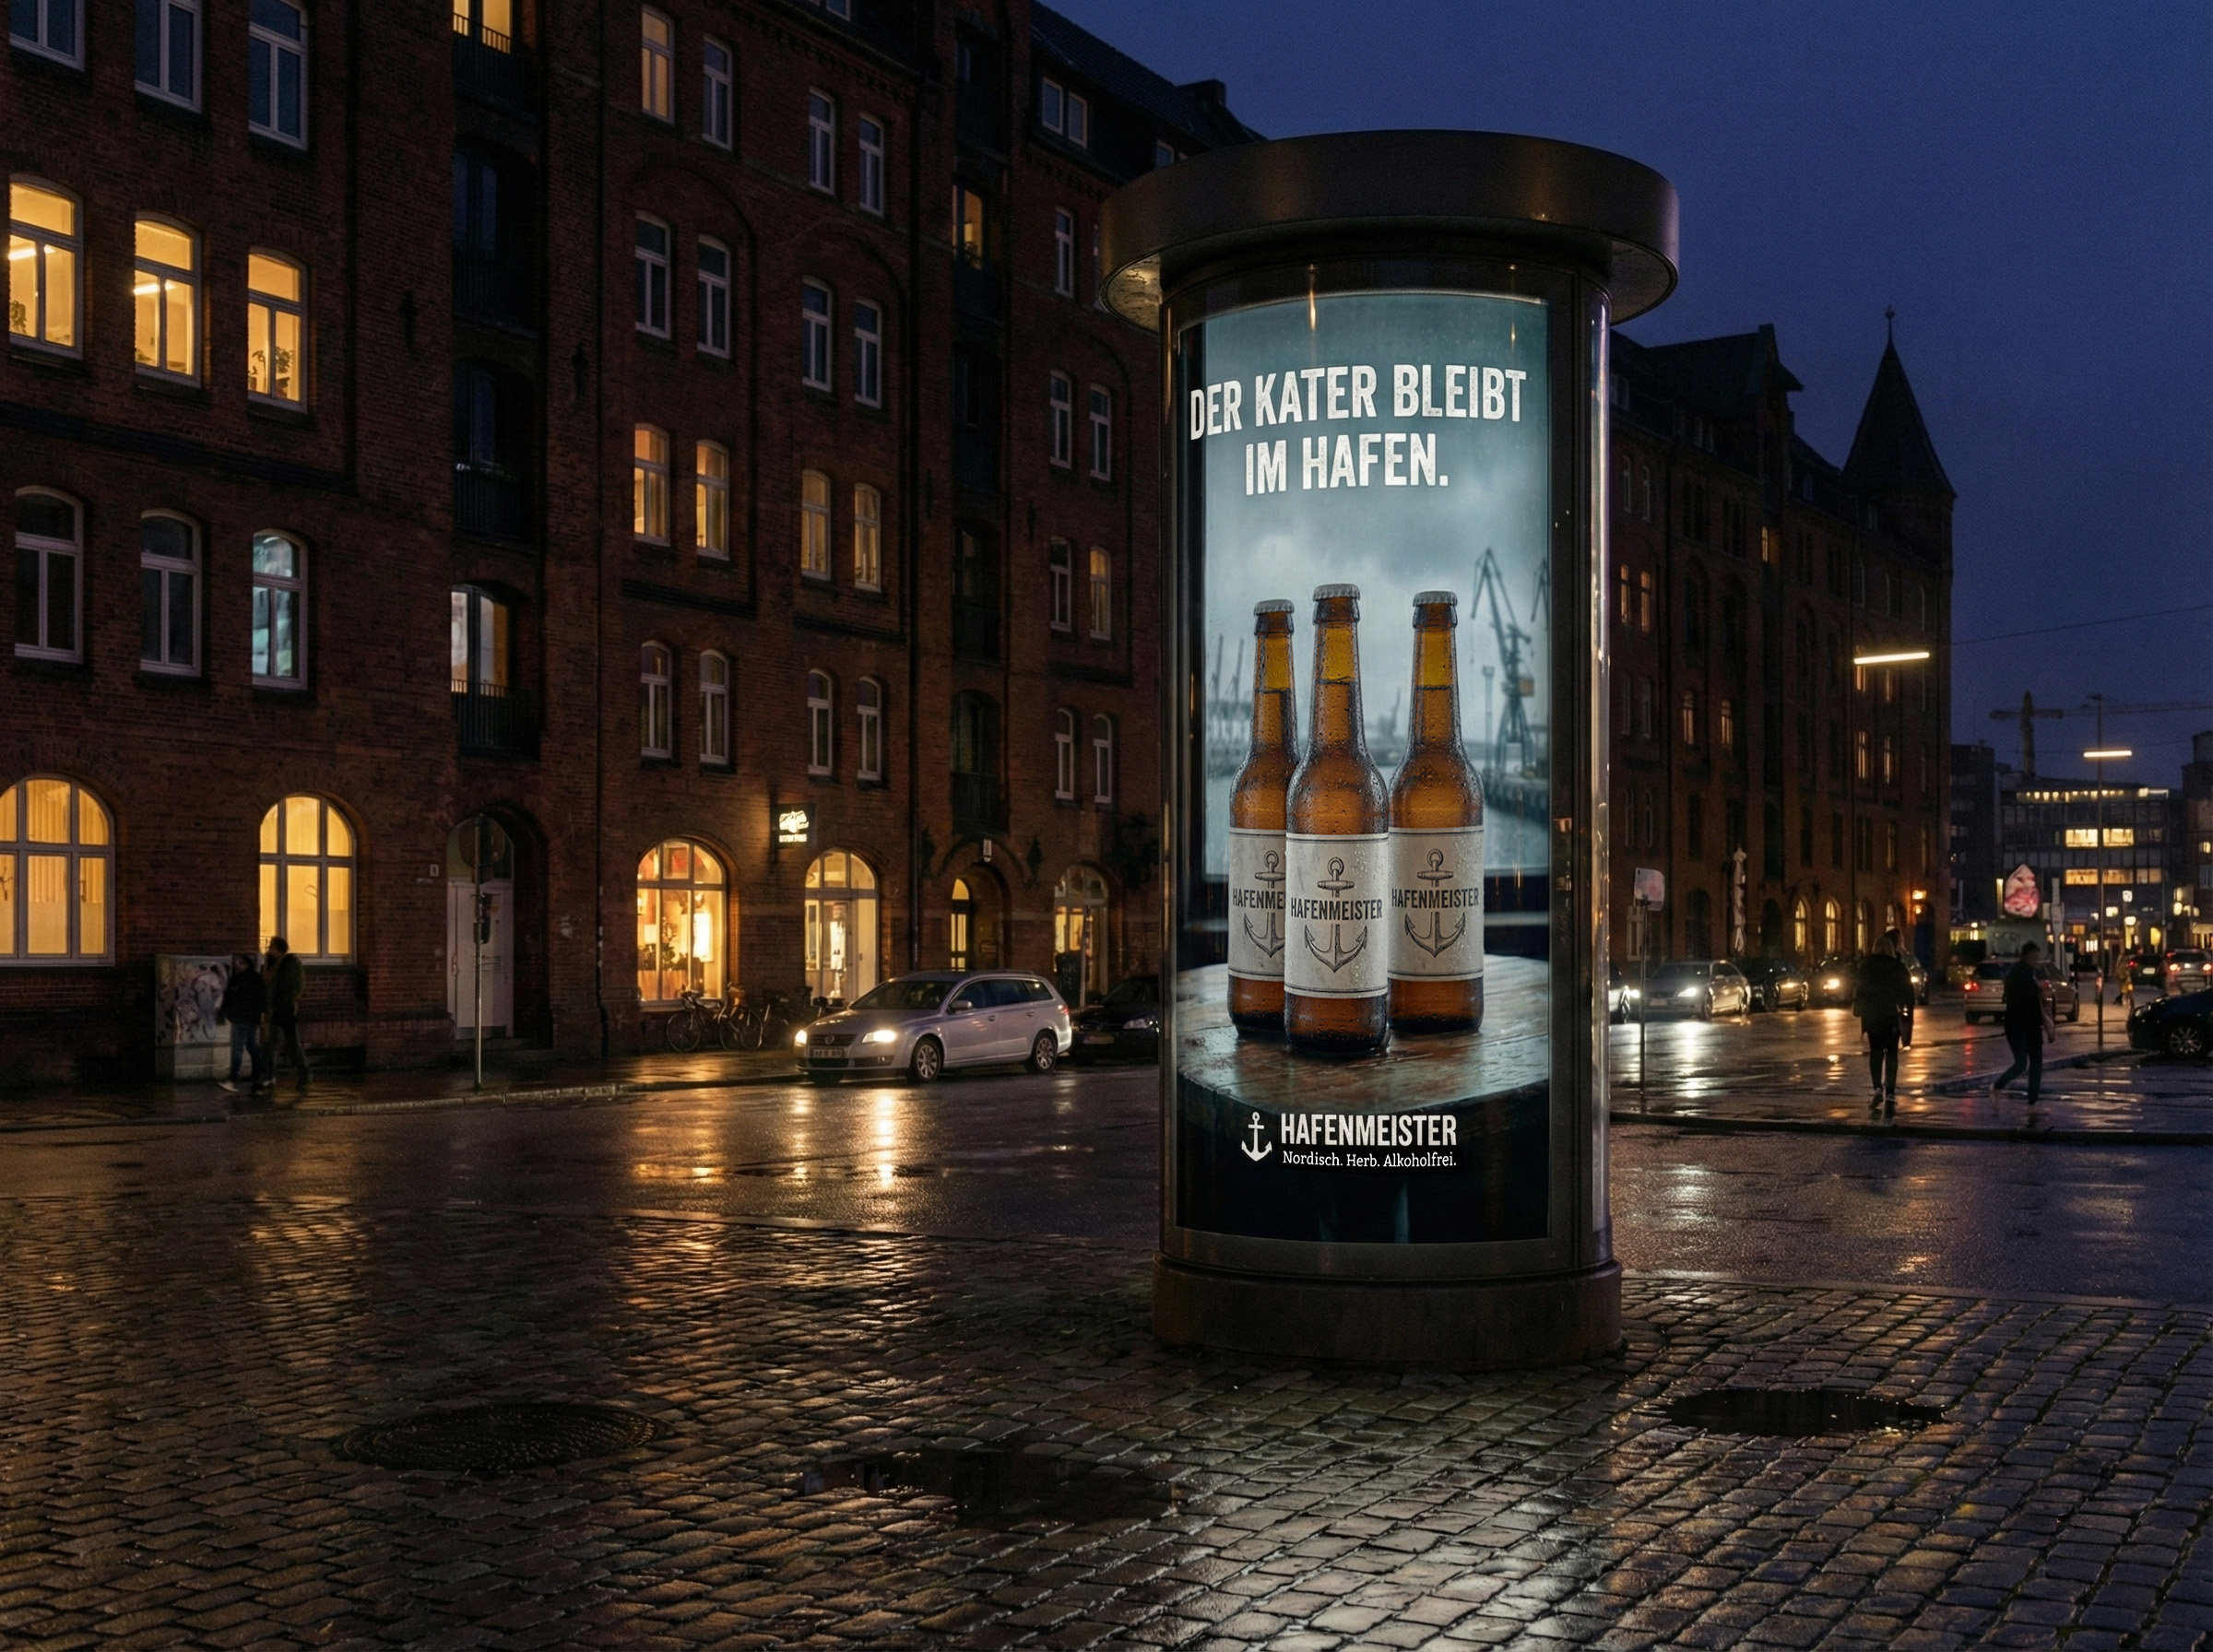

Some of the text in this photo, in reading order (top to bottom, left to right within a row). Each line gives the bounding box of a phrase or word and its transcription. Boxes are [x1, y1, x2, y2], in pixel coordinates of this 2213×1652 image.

[1190, 364, 1527, 441] DER KATER BLEIBT
[1246, 432, 1449, 496] IM HAFEN.
[1232, 888, 1285, 910] HAFENME
[1291, 897, 1382, 921] HAFENMEISTER
[1391, 888, 1479, 909] HAFENMEISTER
[1281, 1113, 1457, 1147] HAFENMEISTER
[1283, 1150, 1457, 1168] Nordisch. Herb. Alkoholfrei.
